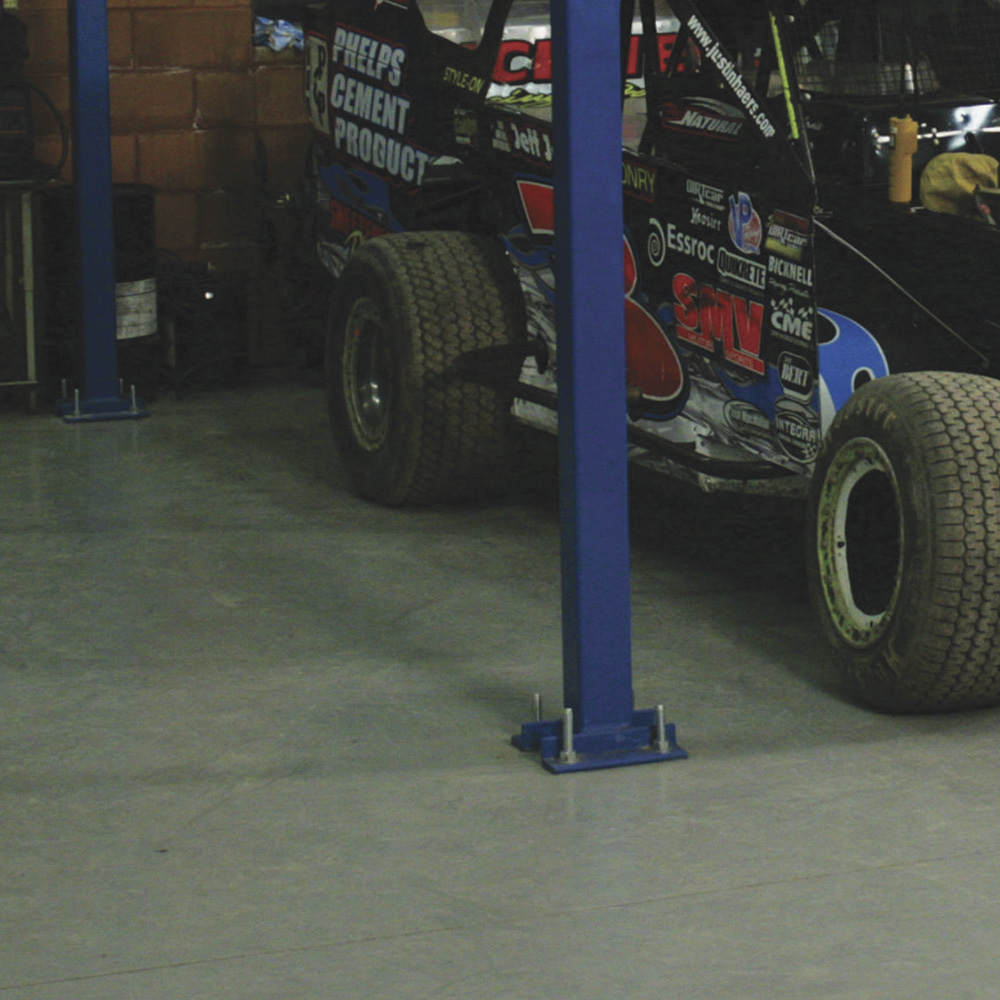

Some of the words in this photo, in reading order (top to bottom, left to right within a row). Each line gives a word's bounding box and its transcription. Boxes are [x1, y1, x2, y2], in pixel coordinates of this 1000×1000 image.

[332, 27, 406, 87] PHELPS
[686, 14, 776, 139] www.justinhaers.com
[330, 72, 411, 135] CEMENT
[682, 110, 744, 136] NATURAL
[335, 116, 429, 186] PRODUCT
[667, 223, 714, 265] Essroc
[768, 255, 812, 287] BICKNELL
[770, 311, 813, 341] CME
